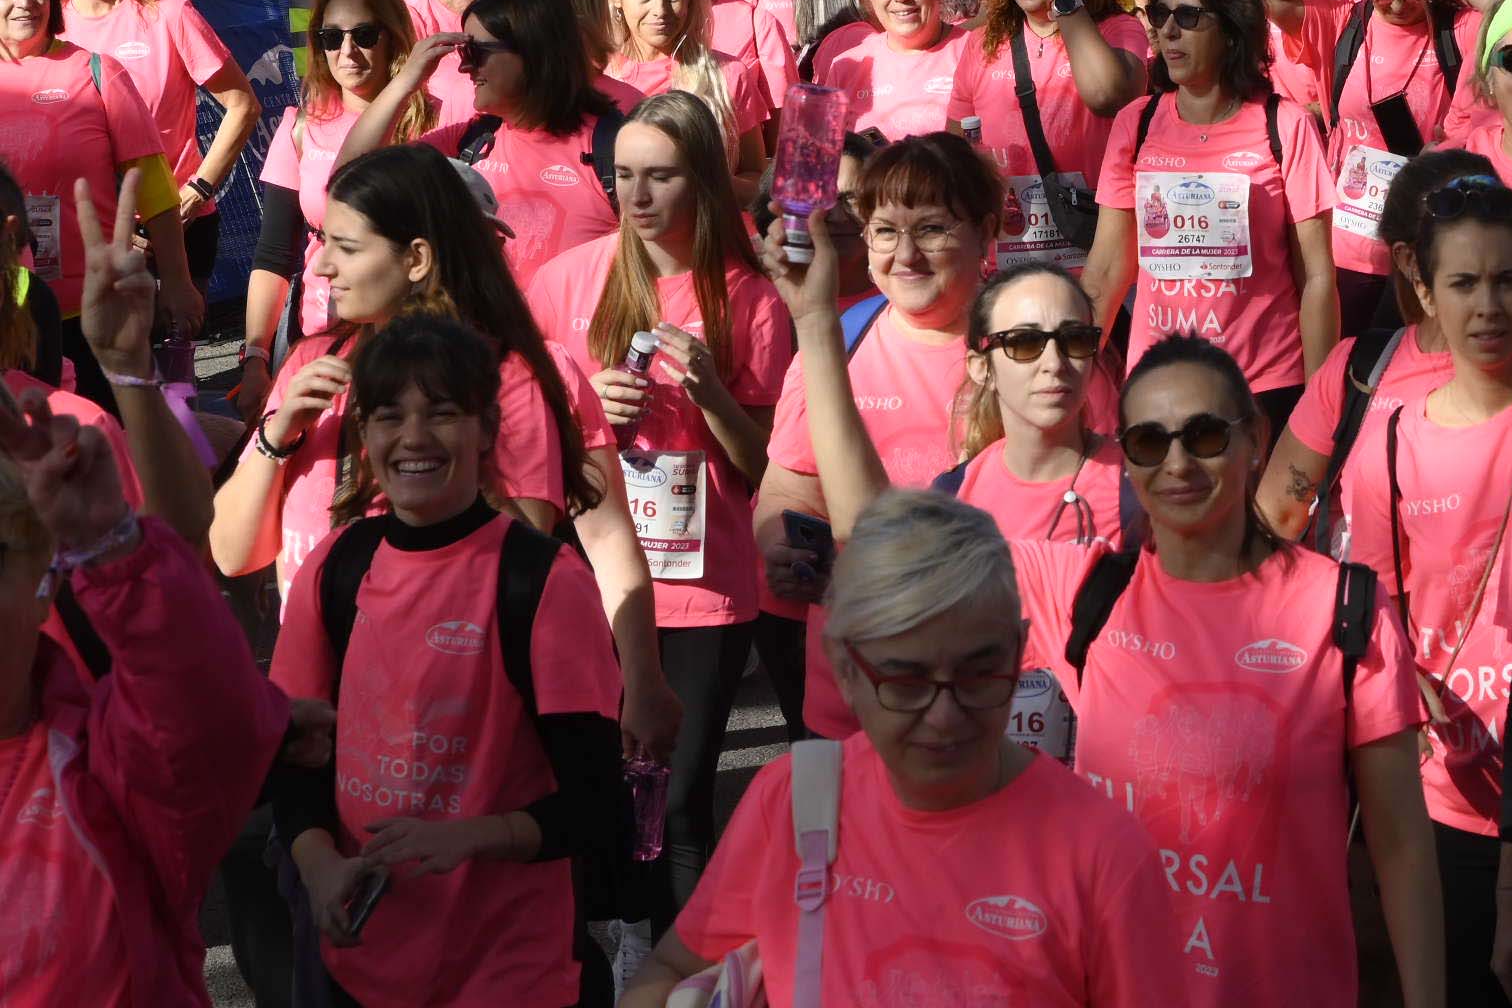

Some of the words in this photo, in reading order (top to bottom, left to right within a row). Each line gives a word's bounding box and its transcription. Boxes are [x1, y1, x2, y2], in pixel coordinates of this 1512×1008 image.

[1344, 118, 1369, 140] TU
[1141, 156, 1186, 168] OYSHO
[1173, 214, 1209, 230] 016
[1178, 234, 1206, 244] 26747
[1182, 248, 1191, 256] DE
[1149, 262, 1181, 272] OYSHO
[1149, 303, 1223, 335] SUMA
[622, 469, 662, 483] STURIANA
[631, 498, 657, 517] 16
[671, 542, 689, 550] 2023
[647, 558, 691, 569] Santander
[1108, 629, 1176, 661] OYSHO
[1240, 649, 1304, 666] ASTURIANA
[1012, 712, 1044, 734] 16
[411, 731, 468, 753] POR
[376, 754, 465, 783] TODAS
